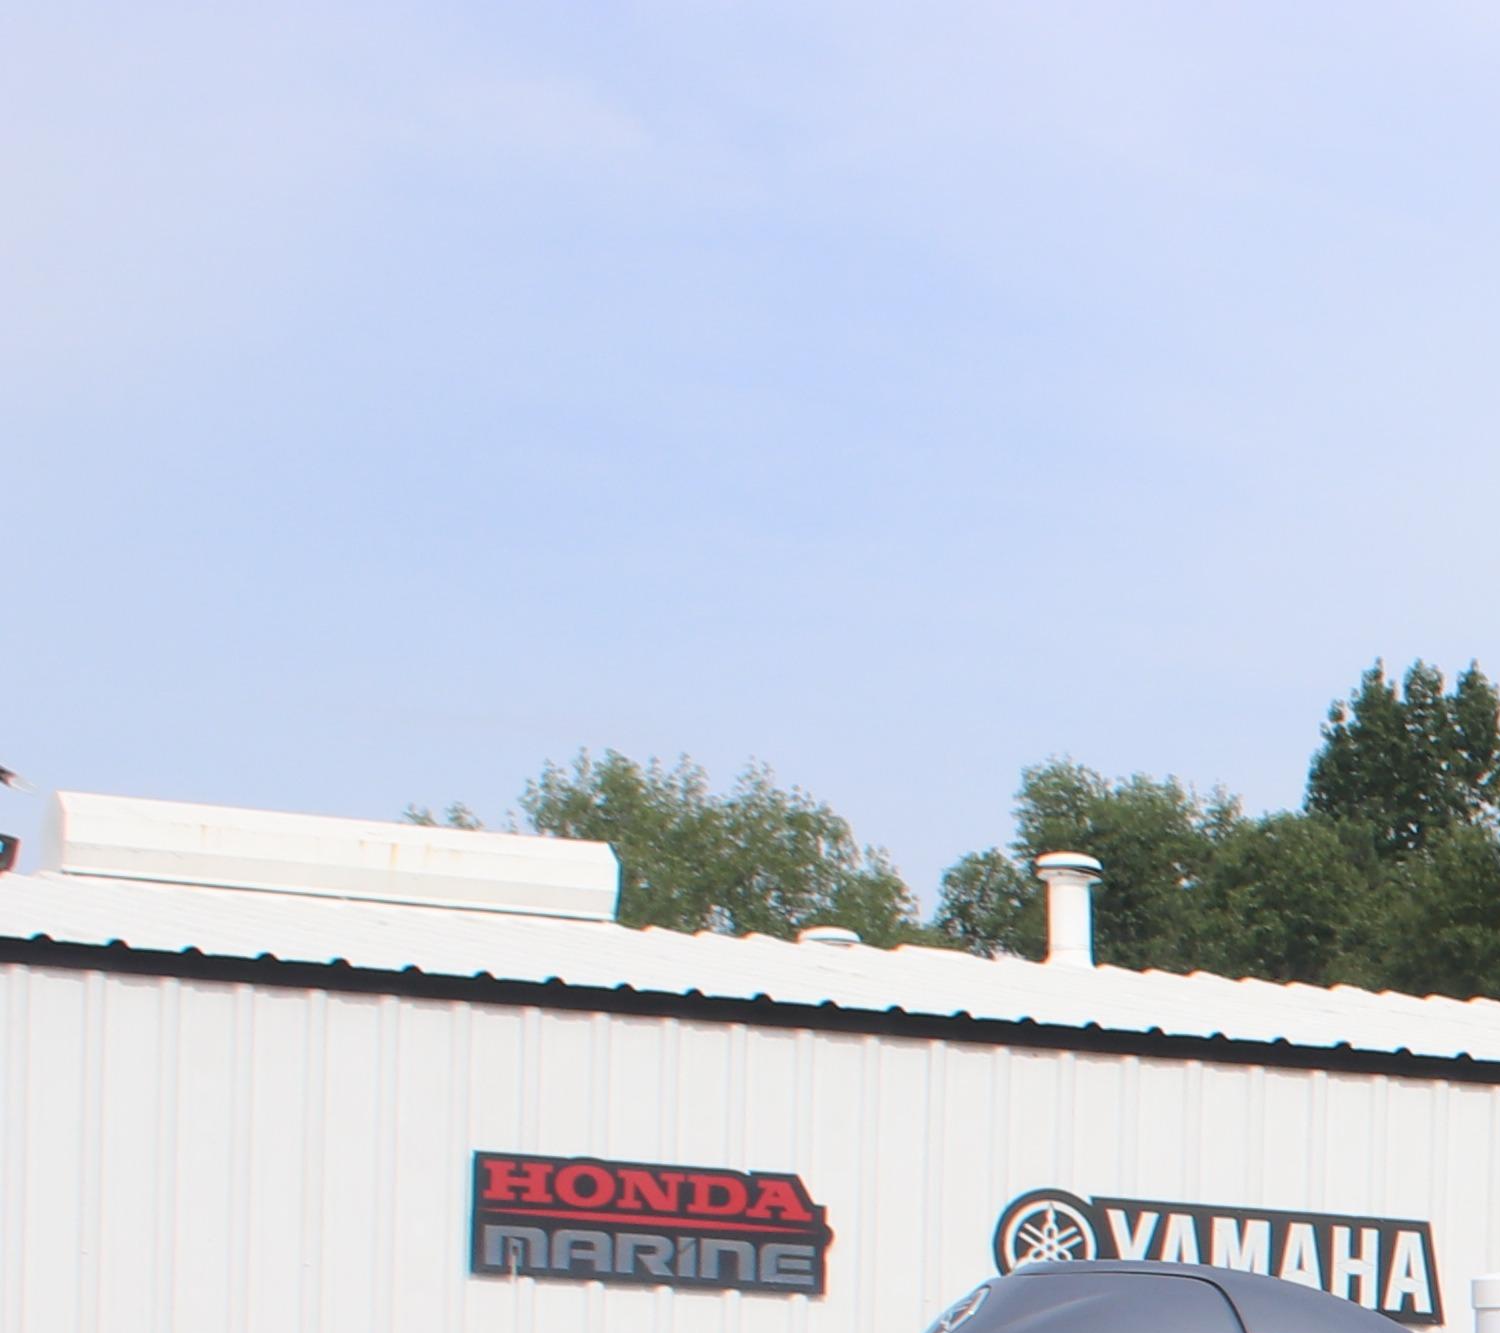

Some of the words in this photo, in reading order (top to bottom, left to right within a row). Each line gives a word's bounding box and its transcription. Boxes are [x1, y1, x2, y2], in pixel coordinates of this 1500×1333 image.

[483, 1159, 814, 1222] HONDA
[484, 1224, 816, 1286] MARINE
[1106, 1207, 1433, 1314] YAMAHA
